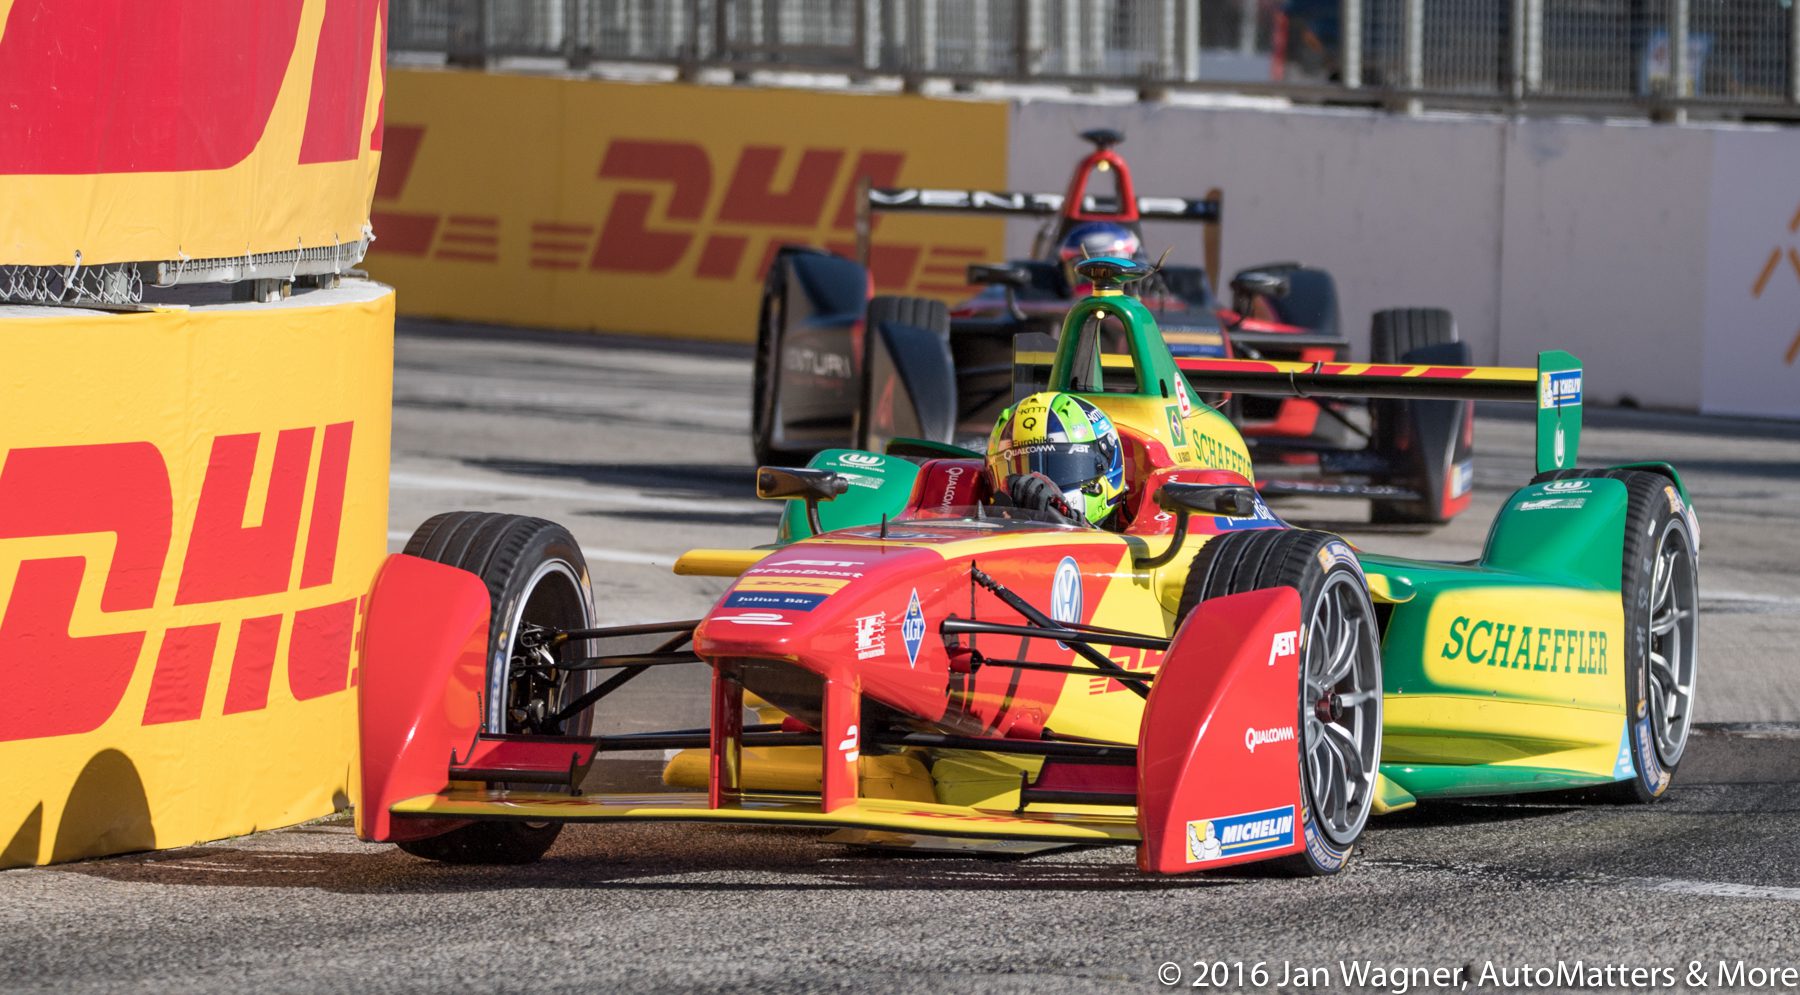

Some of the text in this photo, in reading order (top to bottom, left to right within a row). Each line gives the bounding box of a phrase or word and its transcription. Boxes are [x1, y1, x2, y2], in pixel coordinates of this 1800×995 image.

[590, 138, 924, 288] DHL
[1004, 444, 1056, 461] QUALCOMM
[1068, 444, 1090, 454] ABT
[0, 421, 354, 742] DHL
[748, 568, 863, 579] #FanBoost
[906, 618, 923, 641] LGT
[1268, 630, 1297, 666] ABT
[1441, 615, 1607, 674] SCHAEFFLER
[1245, 726, 1294, 753] QUALCOMM
[1221, 815, 1293, 844] MICHELIN
